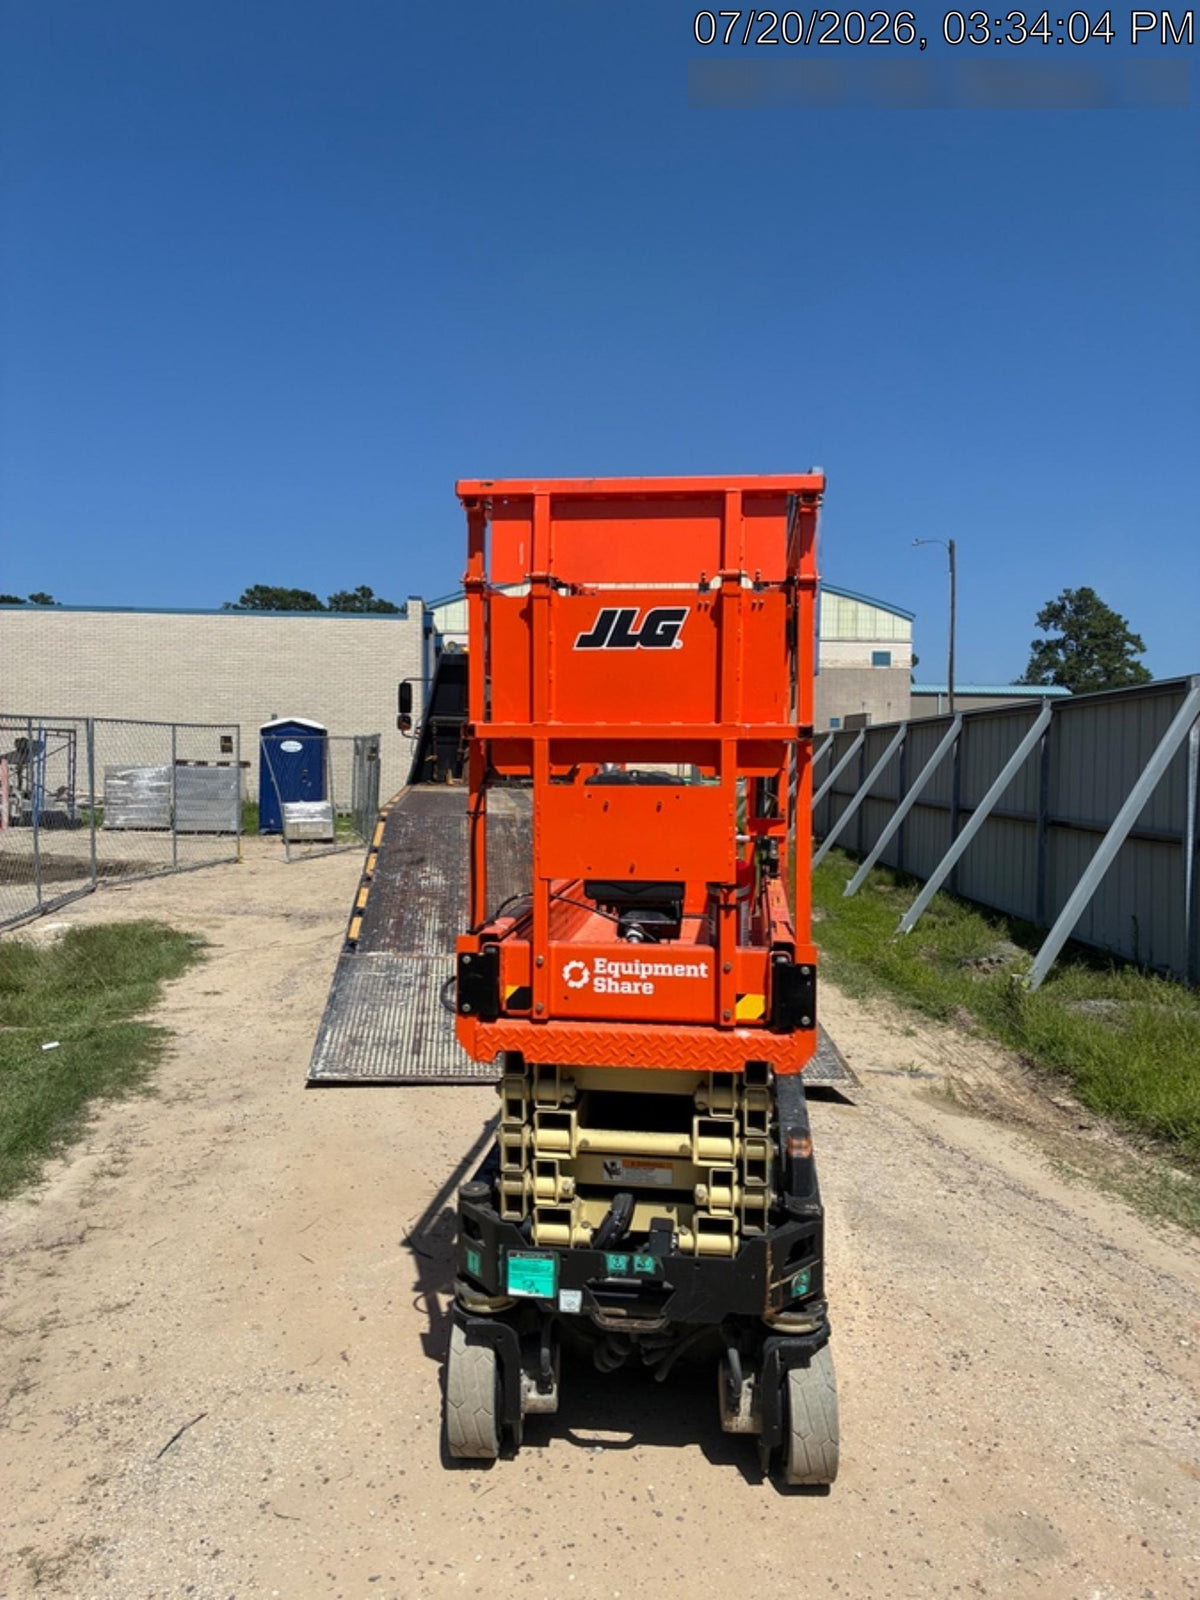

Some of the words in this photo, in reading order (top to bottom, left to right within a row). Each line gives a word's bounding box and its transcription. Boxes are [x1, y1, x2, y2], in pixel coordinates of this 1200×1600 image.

[575, 607, 687, 648] JLG
[593, 957, 708, 978] Equipment
[593, 977, 654, 995] Share
